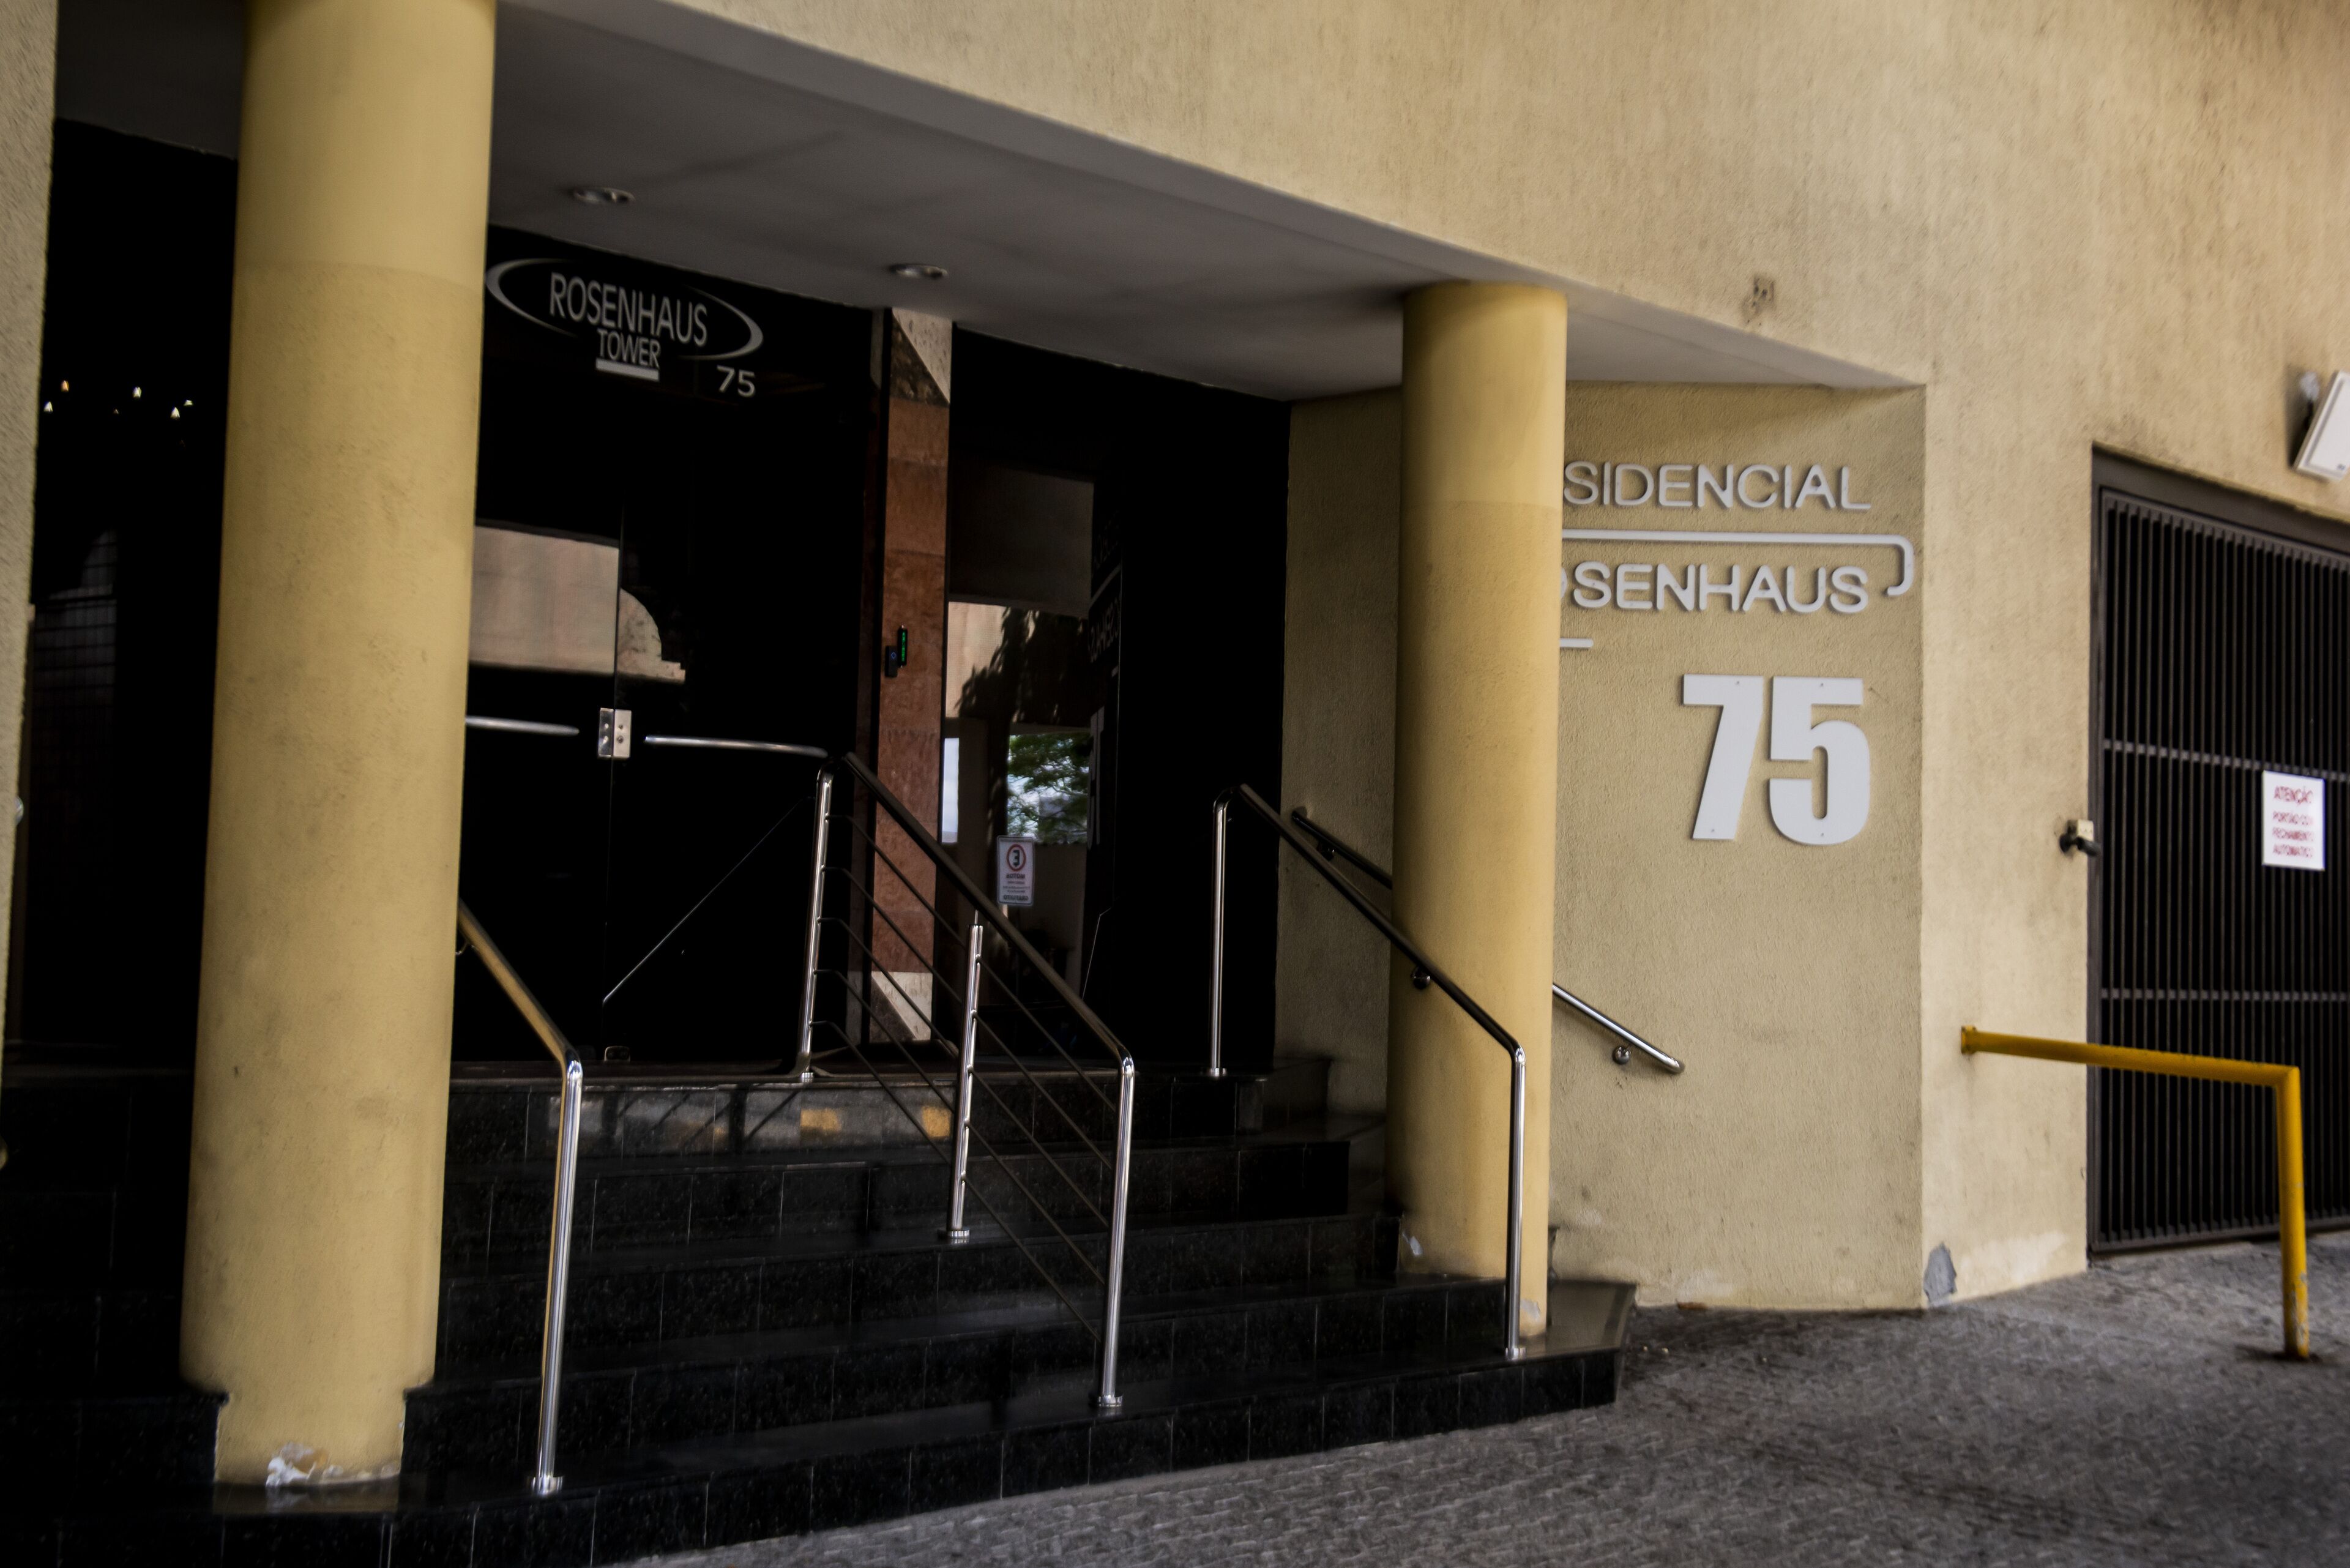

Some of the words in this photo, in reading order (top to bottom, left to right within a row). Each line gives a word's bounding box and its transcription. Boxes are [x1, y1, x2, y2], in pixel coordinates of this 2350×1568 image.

[550, 272, 708, 347] ROSENHAUS
[597, 327, 661, 368] TOWER
[717, 365, 756, 397] 75
[1561, 561, 1869, 614] SENHAUS
[1683, 674, 1870, 845] 75
